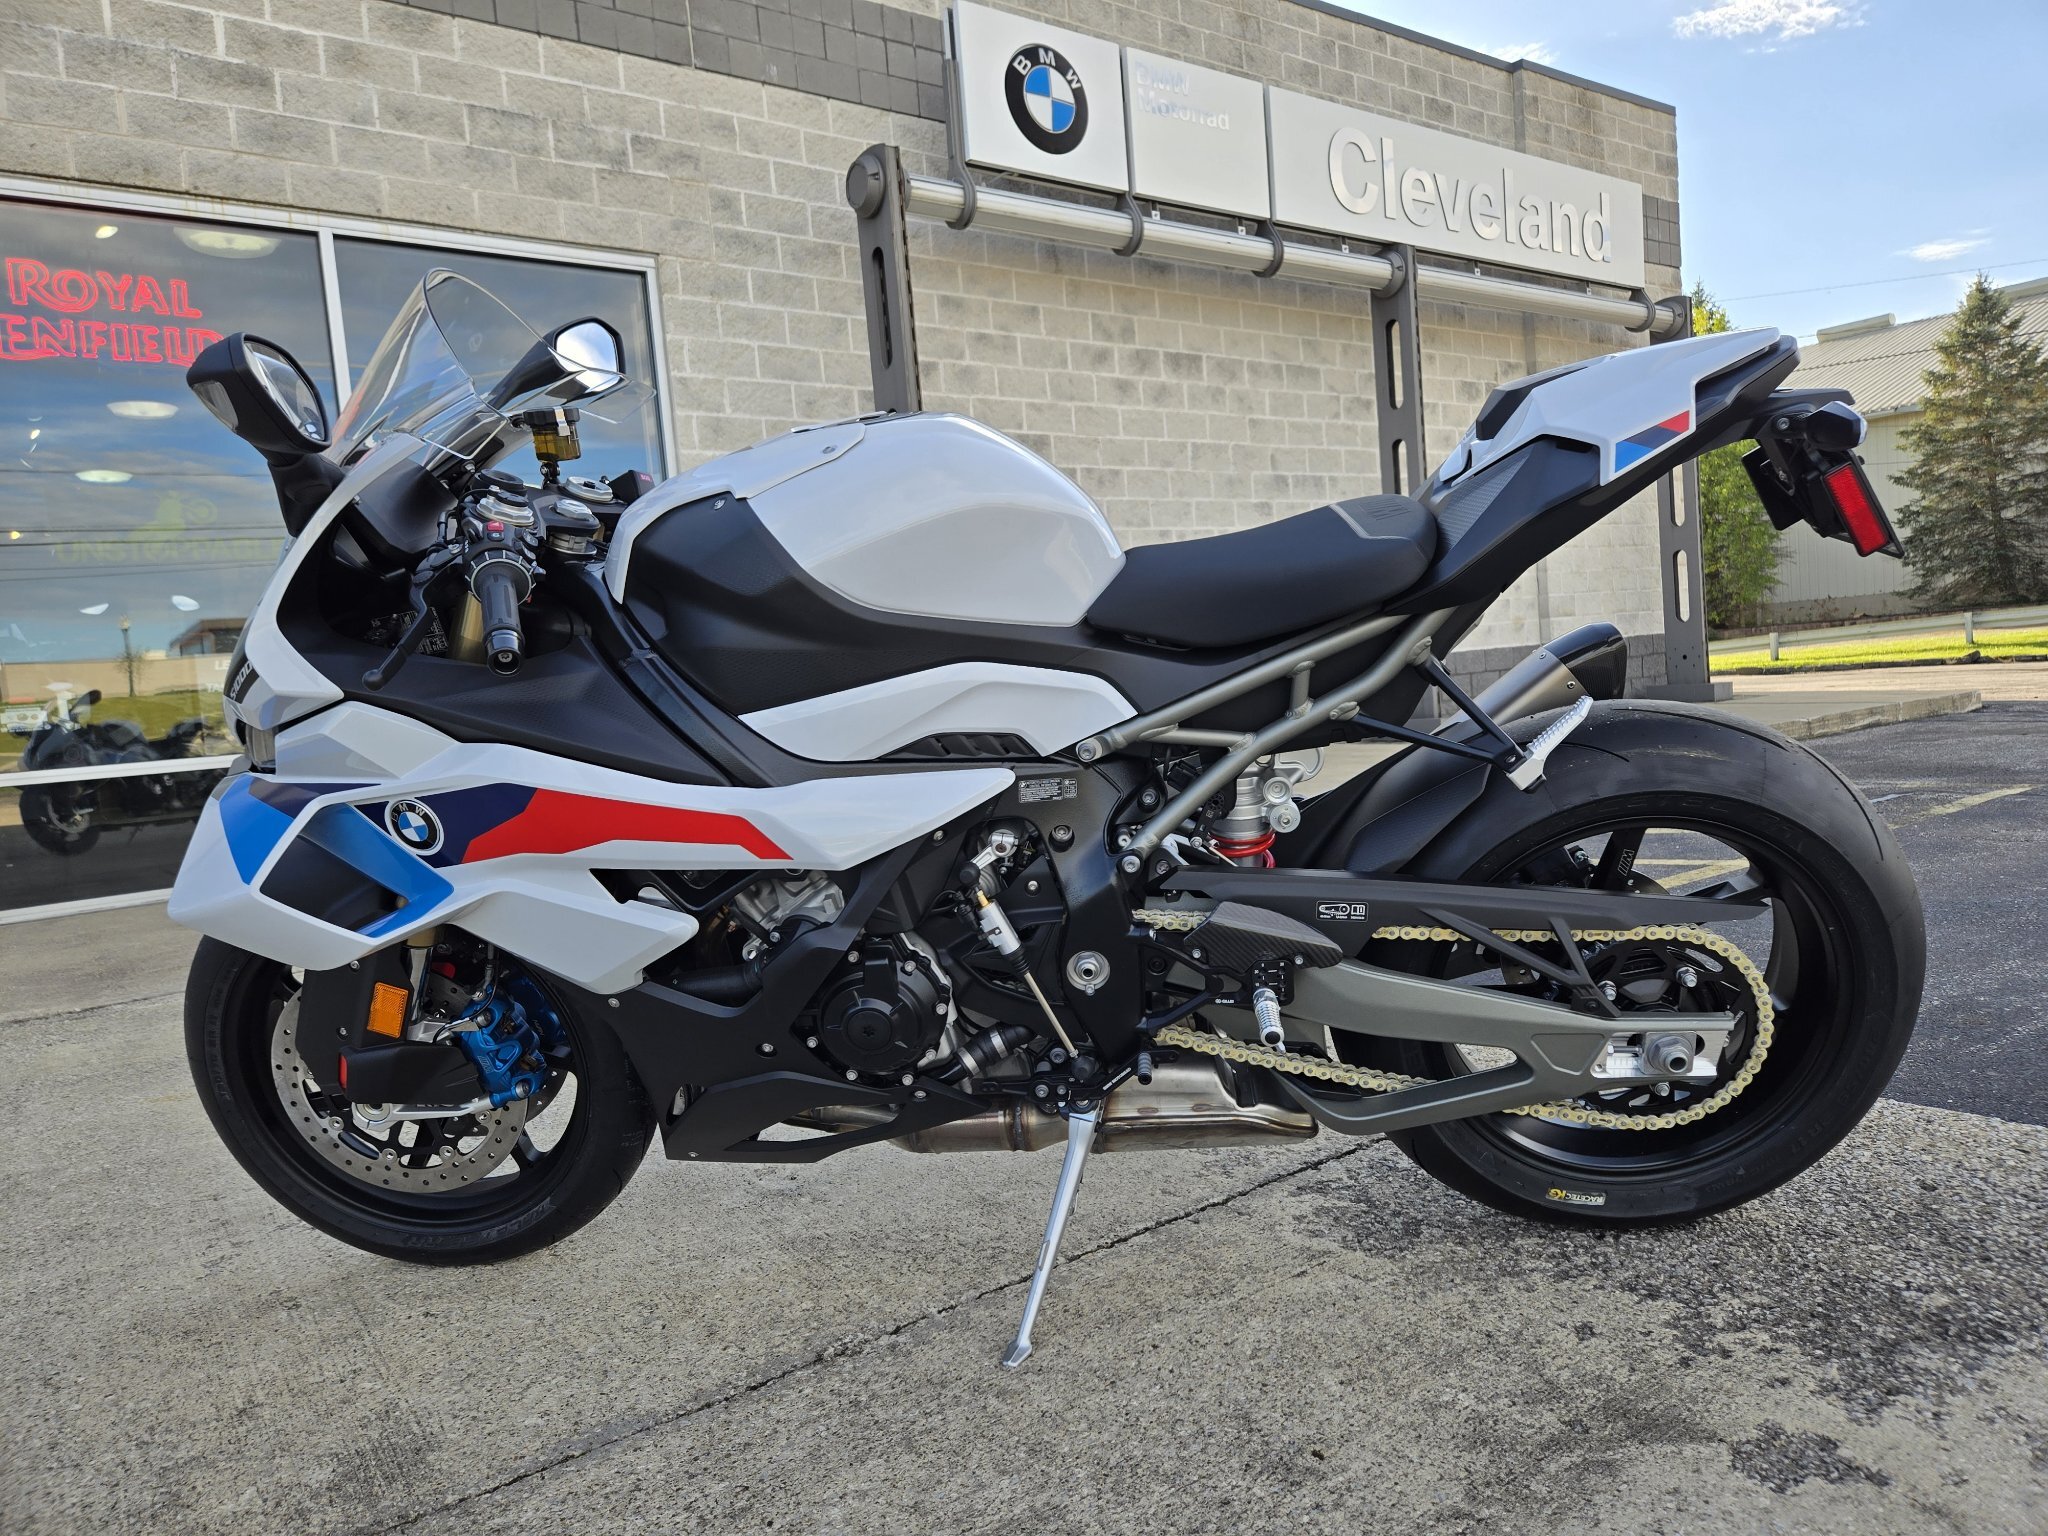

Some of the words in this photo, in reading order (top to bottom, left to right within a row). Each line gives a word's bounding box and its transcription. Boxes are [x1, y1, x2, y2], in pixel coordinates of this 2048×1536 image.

[1011, 48, 1082, 90] BMW
[1137, 88, 1230, 130] Motorrad
[1328, 127, 1612, 263] Cleveland
[5, 256, 203, 319] ROYAL
[390, 802, 426, 823] BMW
[1565, 1192, 1605, 1203] RACETEC
